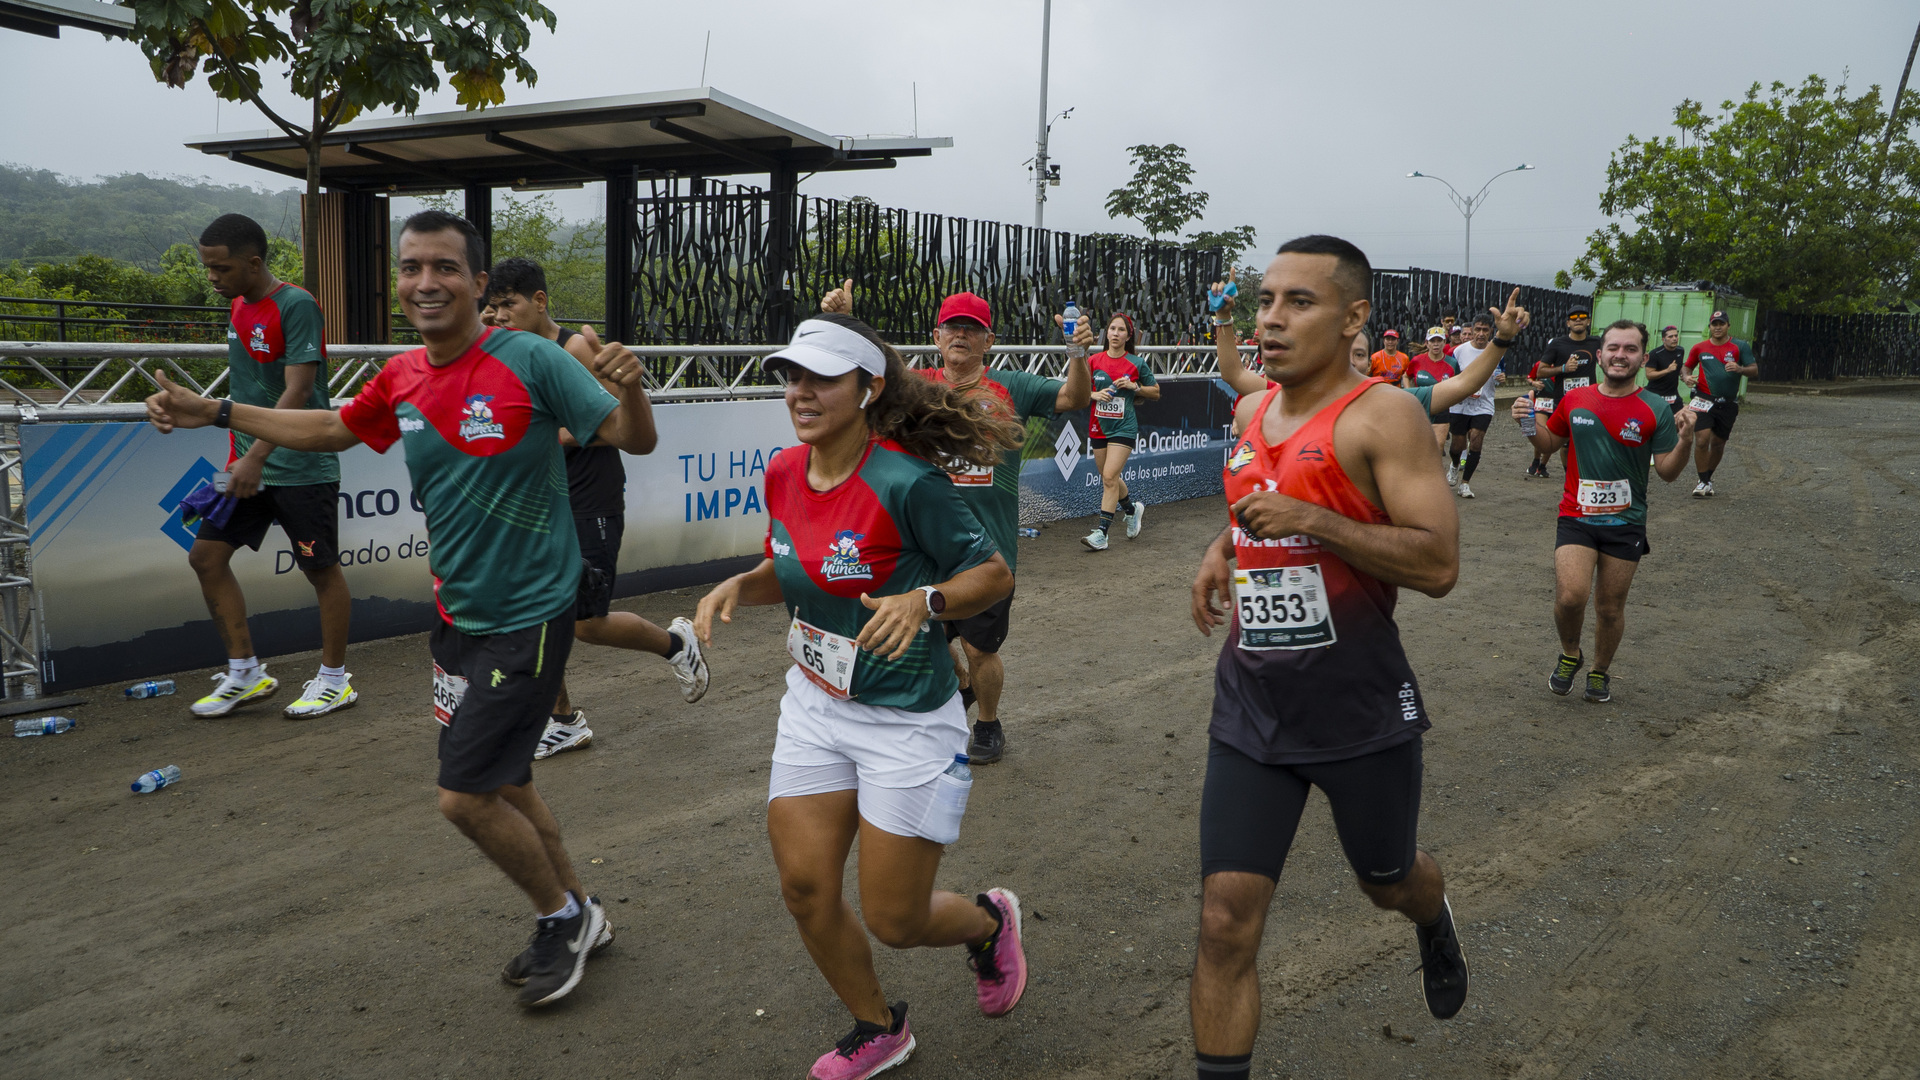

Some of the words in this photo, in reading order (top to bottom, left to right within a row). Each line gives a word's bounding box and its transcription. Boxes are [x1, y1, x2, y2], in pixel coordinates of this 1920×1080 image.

[1099, 403, 1119, 412] 1039
[1149, 429, 1208, 453] Occidente
[678, 452, 715, 483] TU
[1125, 466, 1136, 482] de
[1138, 465, 1150, 479] los
[1152, 464, 1168, 480] que
[1169, 461, 1196, 475] hacen.
[685, 485, 769, 523] IMPA
[1590, 492, 1617, 504] 323
[339, 539, 390, 568] ado
[397, 534, 429, 560] de
[820, 561, 872, 579] Muñeca
[1241, 593, 1306, 624] 5353
[803, 644, 825, 674] 65
[1398, 681, 1418, 721] RH:B+
